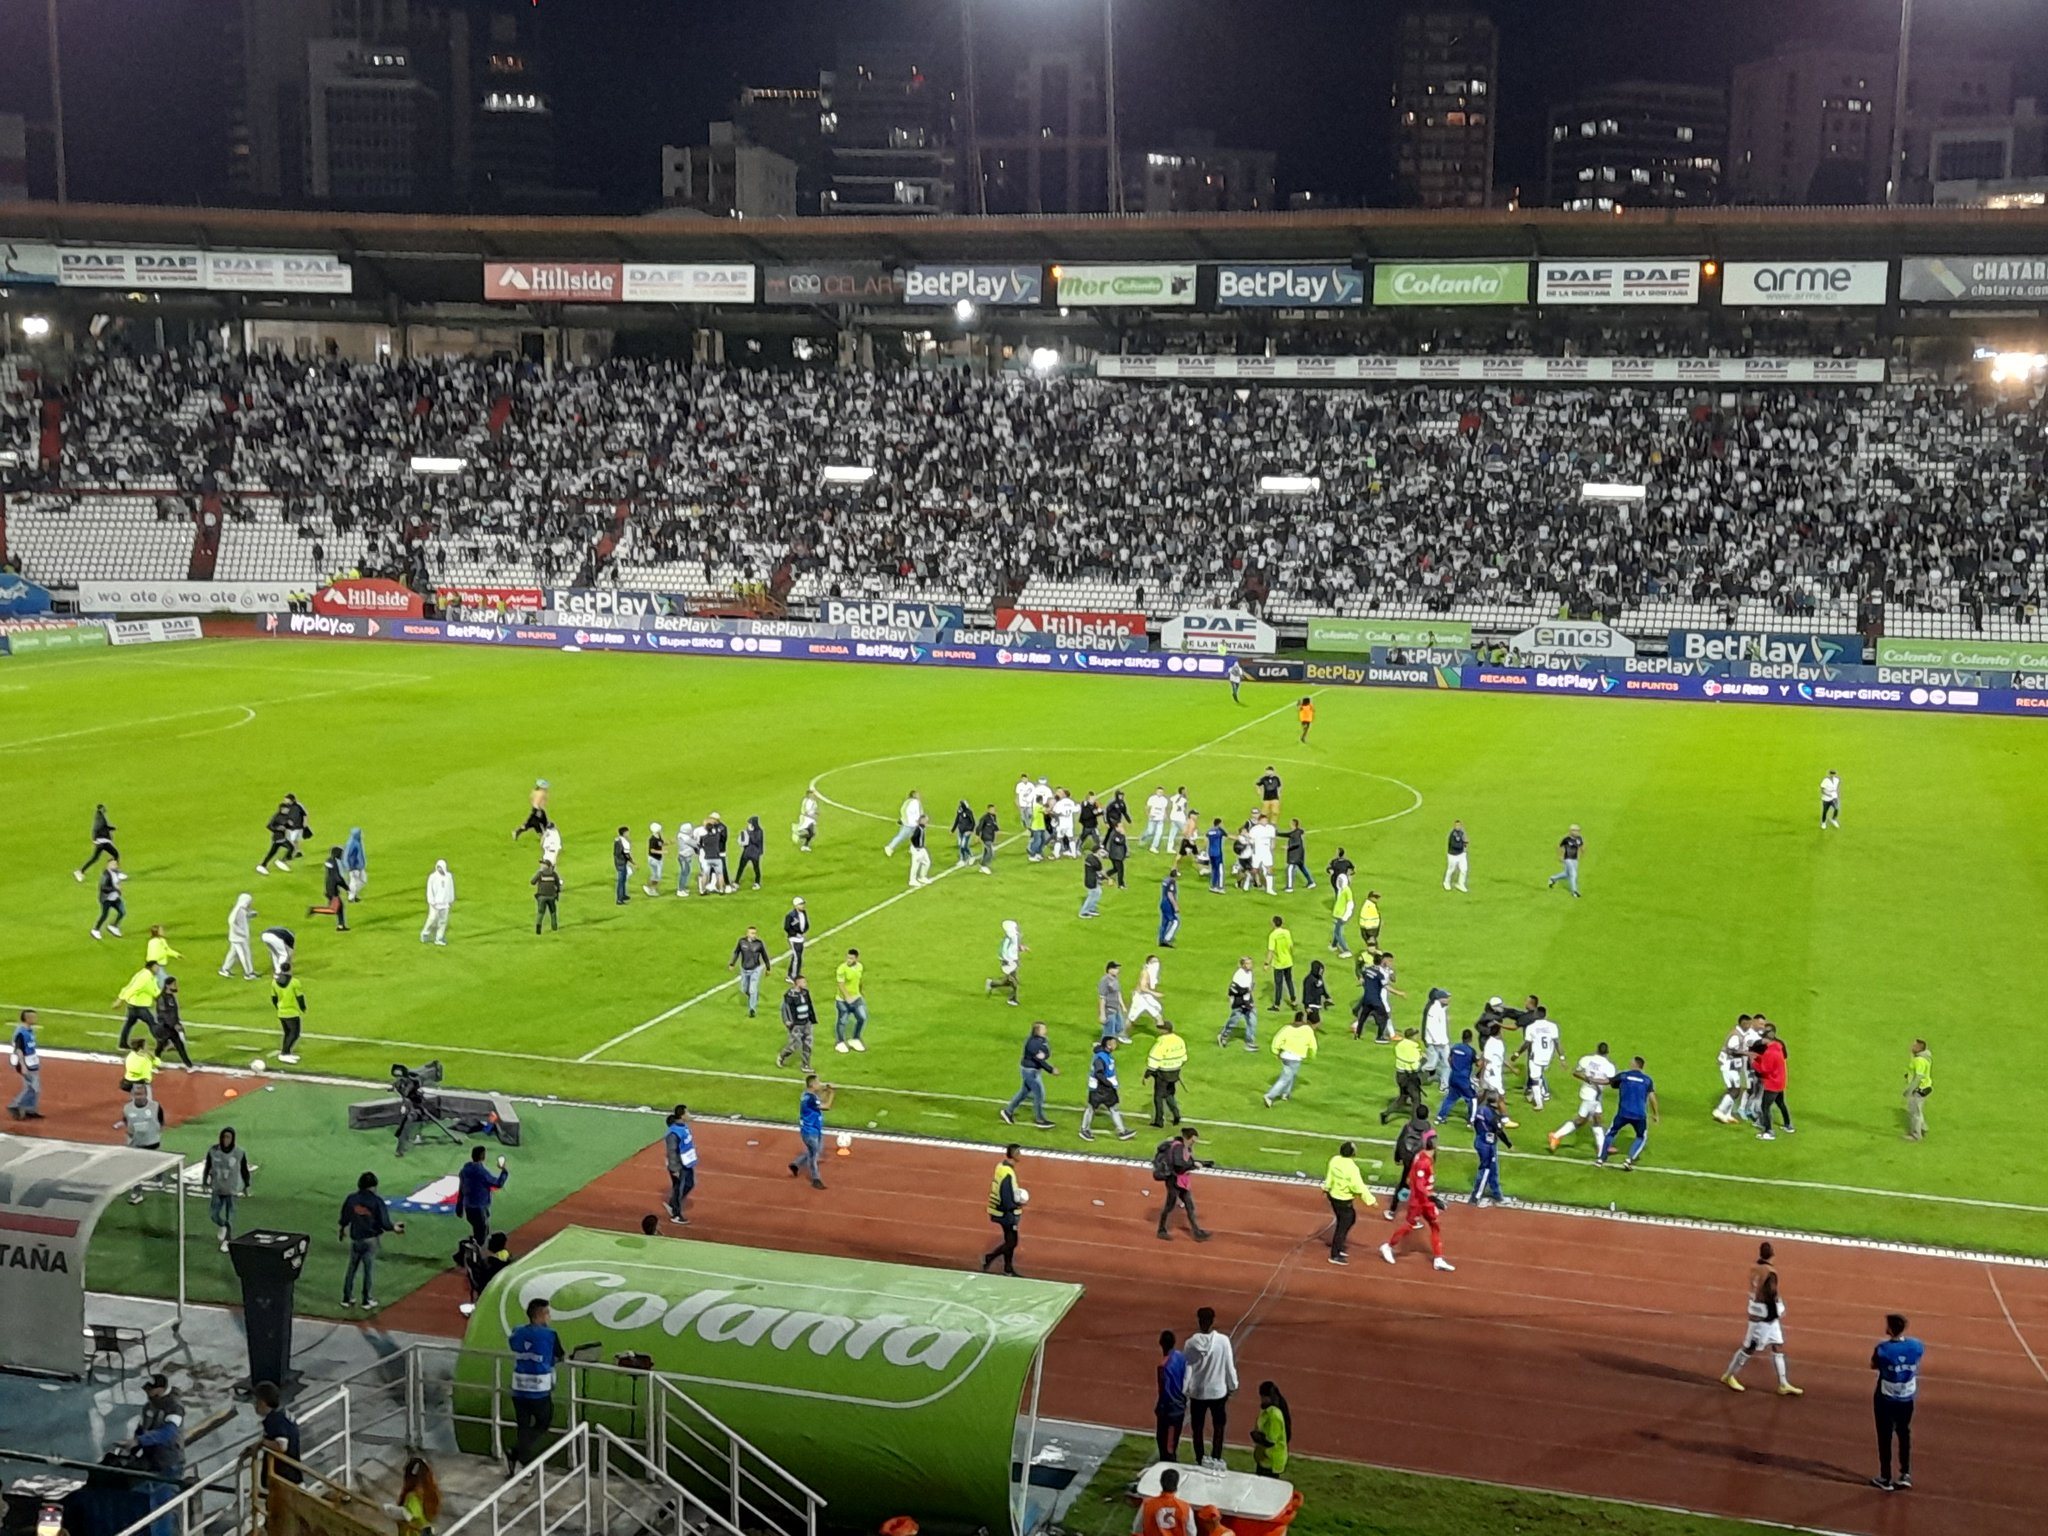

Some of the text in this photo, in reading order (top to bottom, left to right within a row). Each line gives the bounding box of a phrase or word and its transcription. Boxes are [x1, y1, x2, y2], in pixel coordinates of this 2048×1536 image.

[62, 255, 124, 266] DAF
[135, 256, 197, 267] DAF
[532, 267, 613, 290] Hillside
[1394, 272, 1500, 295] Colanta
[1547, 269, 1612, 281] DAF
[1624, 269, 1690, 281] DAF
[1754, 268, 1852, 292] arme
[907, 269, 1007, 302] BetPlay
[1220, 269, 1327, 302] BetPlay
[349, 587, 409, 607] Hillside
[554, 590, 652, 617] BetPlay
[558, 612, 614, 628] BetPlay
[829, 602, 926, 628] BetPlay
[1184, 616, 1257, 632] DAF
[291, 616, 355, 636] Wplay.co
[447, 624, 495, 641] BetPlay
[655, 616, 709, 633] BetPlay
[752, 621, 808, 636] BetPlay
[1042, 614, 1130, 637] Hillside
[632, 635, 641, 645] Y
[659, 636, 691, 650] Super
[850, 625, 909, 643] BetPlay
[954, 630, 1013, 647] BetPlay
[1056, 634, 1117, 652] BetPlay
[1537, 629, 1610, 647] emas
[857, 643, 910, 661] BetPlay
[1059, 654, 1069, 665] Y
[1089, 655, 1123, 668] Super
[1883, 650, 1943, 664] Colanta
[1951, 651, 2011, 665] Colanta
[1258, 664, 1429, 683] LIGA BetPlay DIMAYOR
[1625, 658, 1695, 676] BetPlay
[1750, 662, 1821, 681] BetPlay
[1480, 674, 1527, 685] RECARGA
[1536, 673, 1598, 691] BetPlay
[1642, 681, 1679, 692] PUNTOS
[1878, 667, 1952, 687] BetPlay
[1779, 685, 1790, 697] Y
[1815, 687, 1856, 701] Super
[1858, 690, 1902, 701] GIROS
[519, 1270, 976, 1371] Colanta
